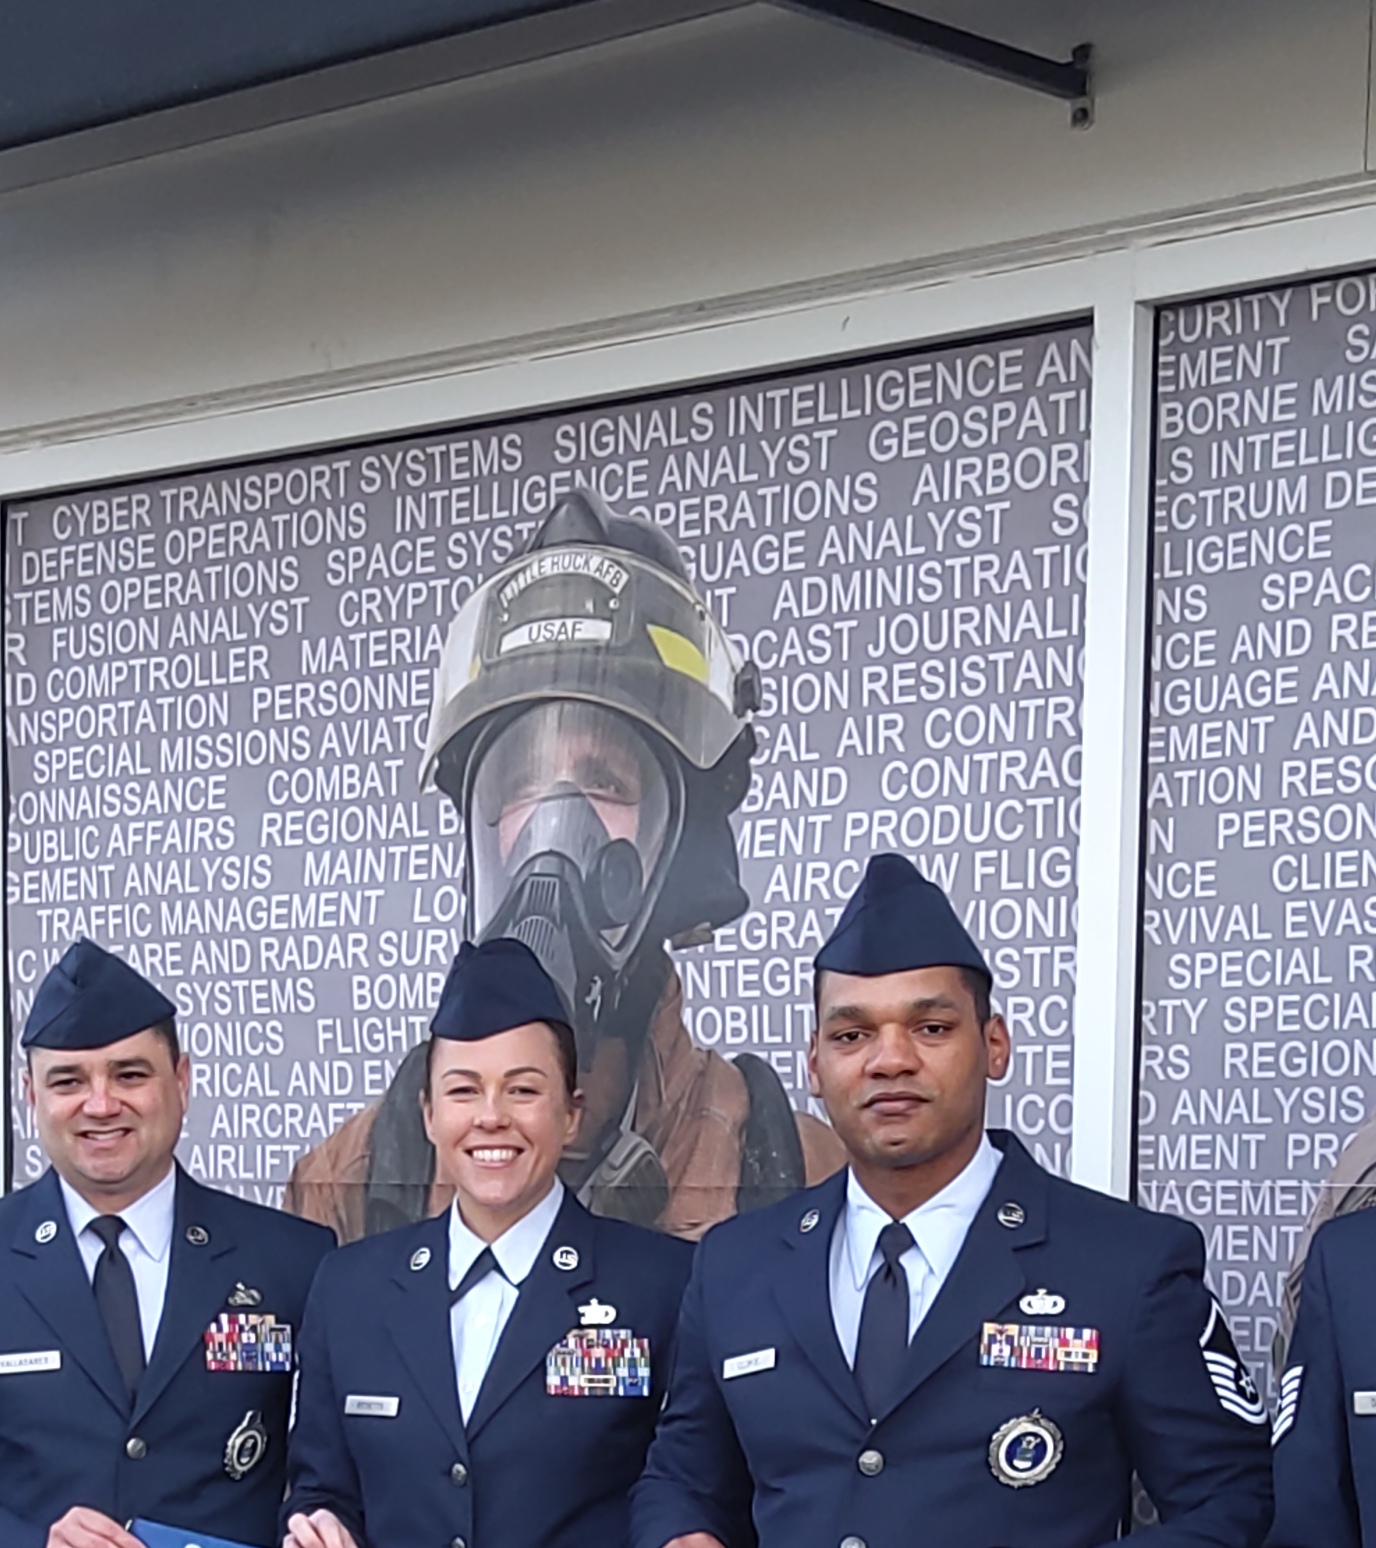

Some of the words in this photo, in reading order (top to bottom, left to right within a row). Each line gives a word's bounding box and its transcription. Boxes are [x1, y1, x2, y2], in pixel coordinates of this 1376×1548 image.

[52, 494, 153, 537] CYBER
[159, 460, 351, 525] TRANSPORT
[360, 433, 522, 494] SYSTEMS
[553, 403, 714, 464] SIGNALS
[728, 348, 1025, 434] INTELLIGENCE
[22, 533, 156, 585] DEFENSE
[164, 502, 367, 566] OPERATIONS
[658, 428, 838, 495] ANALYST
[868, 388, 1092, 463] GEOSPATI
[52, 615, 159, 663] FUSION
[168, 596, 310, 649] ANALYST
[818, 500, 1010, 565] ANALYST
[100, 555, 299, 615] OPERATIONS
[326, 535, 436, 586] SPACE
[594, 558, 623, 588] AFB
[528, 620, 585, 642] USAF
[1230, 618, 1312, 664] AND
[46, 645, 270, 703] COMPTROLLER
[33, 740, 152, 784] SPECIAL
[160, 725, 311, 773] MISSIONS
[268, 758, 404, 806] COMBAT
[836, 712, 904, 758] AIR
[106, 815, 235, 858] AFFAIRS
[260, 801, 429, 848] REGIONAL
[123, 853, 272, 898] ANALYSIS
[36, 902, 152, 943] TRAFFIC
[160, 889, 385, 936] MANAGEMENT
[190, 938, 251, 976] AND
[260, 932, 370, 973] RADAR
[1168, 946, 1333, 990] SPECIAL
[175, 977, 316, 1017] SYSTEMS
[287, 1060, 353, 1097] AND
[1171, 1085, 1365, 1126] ANALYSIS
